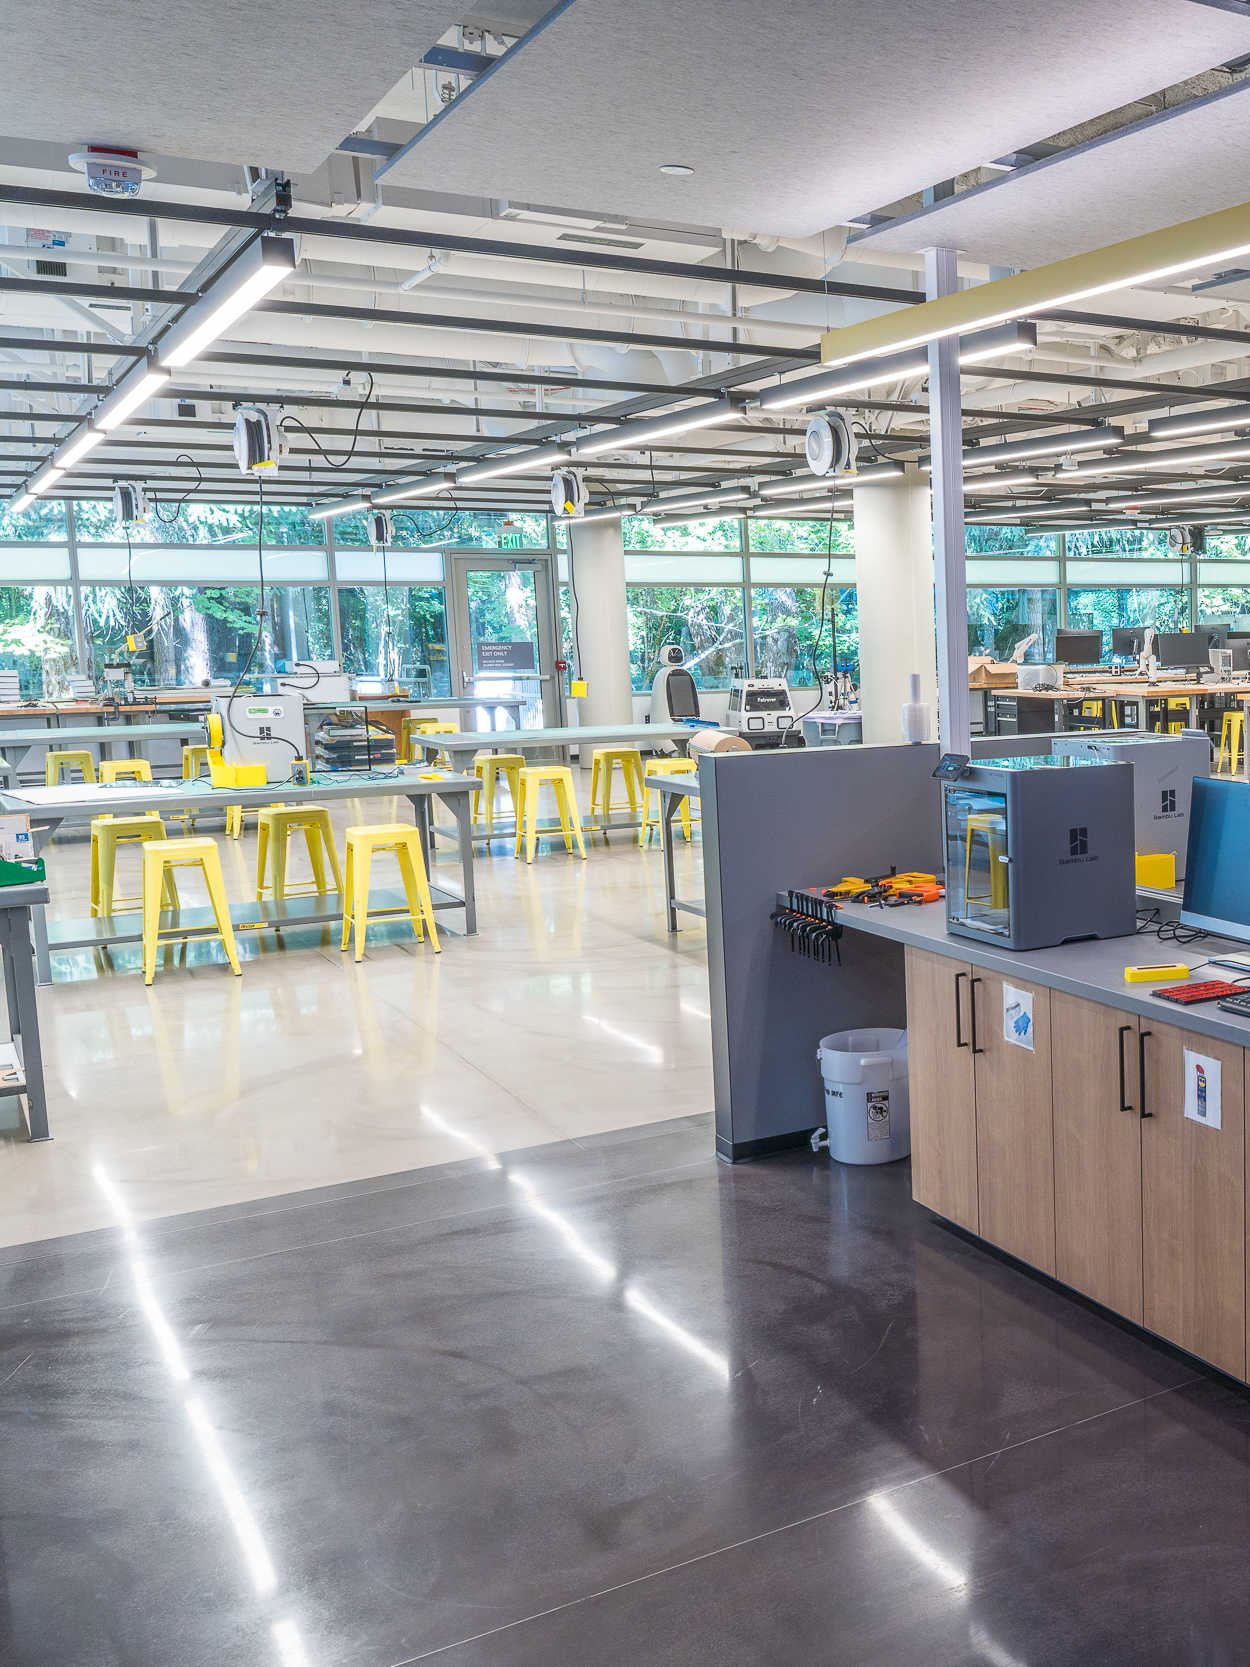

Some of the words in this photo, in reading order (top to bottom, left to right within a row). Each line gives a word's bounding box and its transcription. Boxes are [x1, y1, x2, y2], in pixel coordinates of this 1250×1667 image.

[102, 168, 128, 178] FIRE
[501, 533, 520, 548] EXIT
[1060, 857, 1084, 865] Bambu
